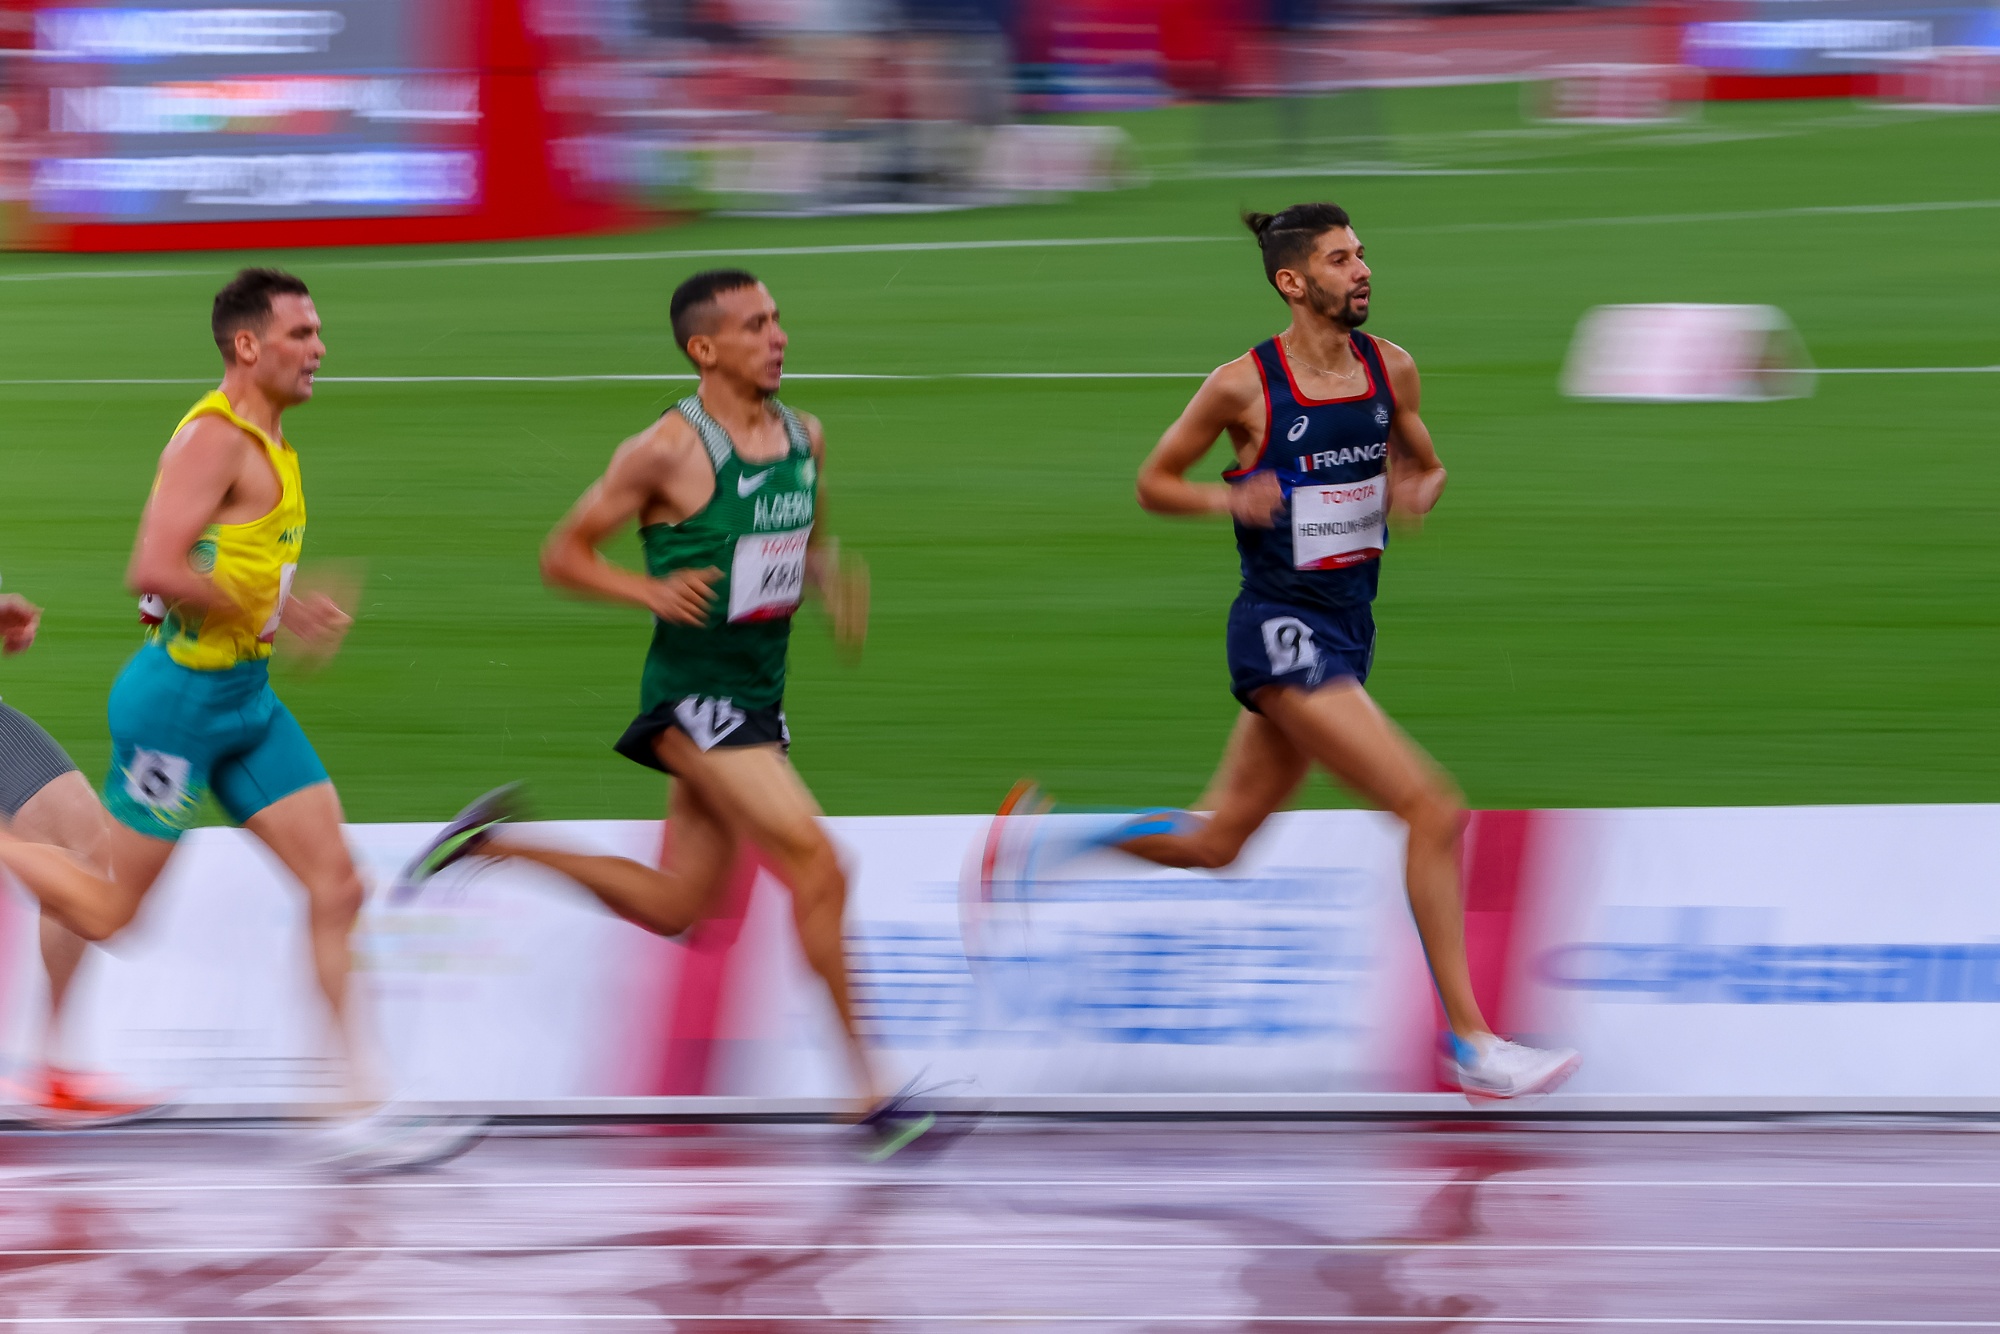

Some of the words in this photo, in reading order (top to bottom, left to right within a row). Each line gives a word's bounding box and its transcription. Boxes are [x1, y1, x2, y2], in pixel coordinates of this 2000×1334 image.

[1312, 442, 1387, 470] FRANCE
[1318, 484, 1376, 504] TOYOTA
[1275, 624, 1302, 667] 9
